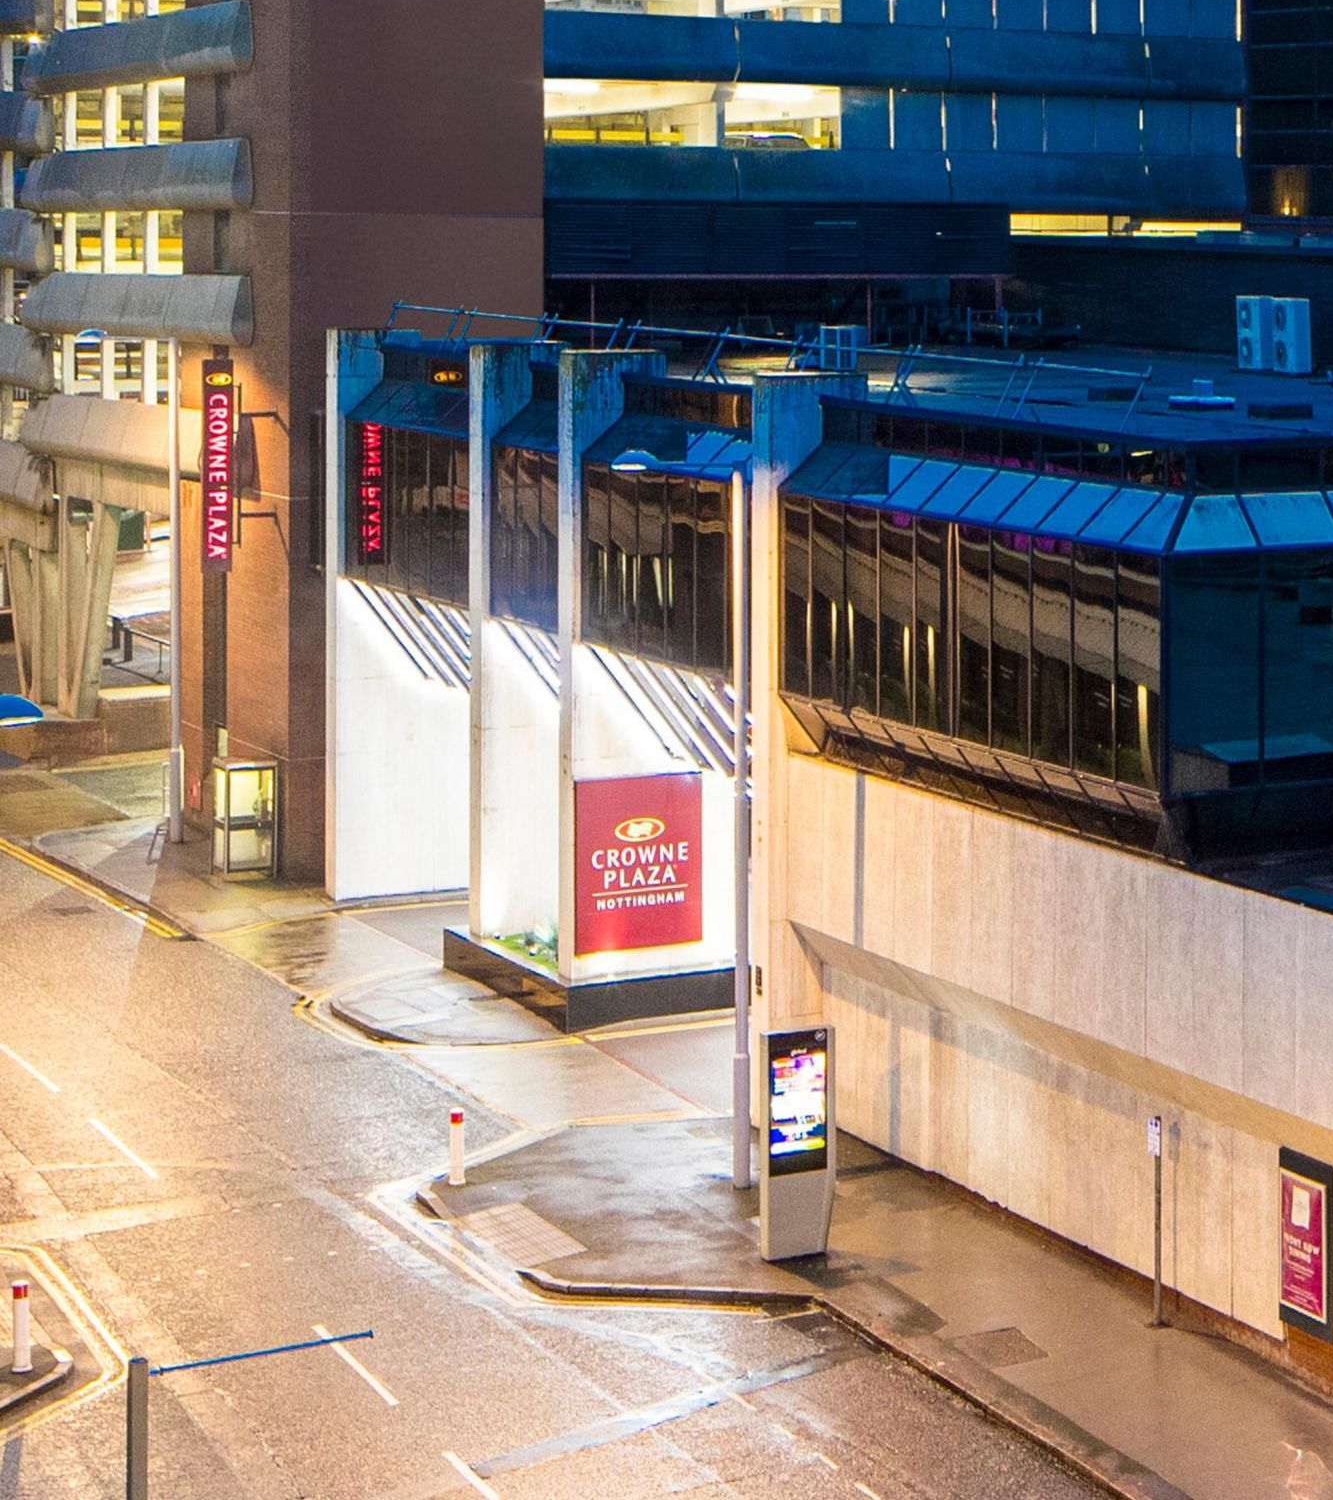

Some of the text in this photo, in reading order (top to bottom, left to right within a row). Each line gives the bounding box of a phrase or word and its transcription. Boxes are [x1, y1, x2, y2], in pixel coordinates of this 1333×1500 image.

[207, 393, 229, 558] CROWNE PLAZA
[591, 841, 690, 871] CROWNE
[603, 865, 676, 891] PLAZA
[596, 891, 685, 912] NOTTINGHAM
